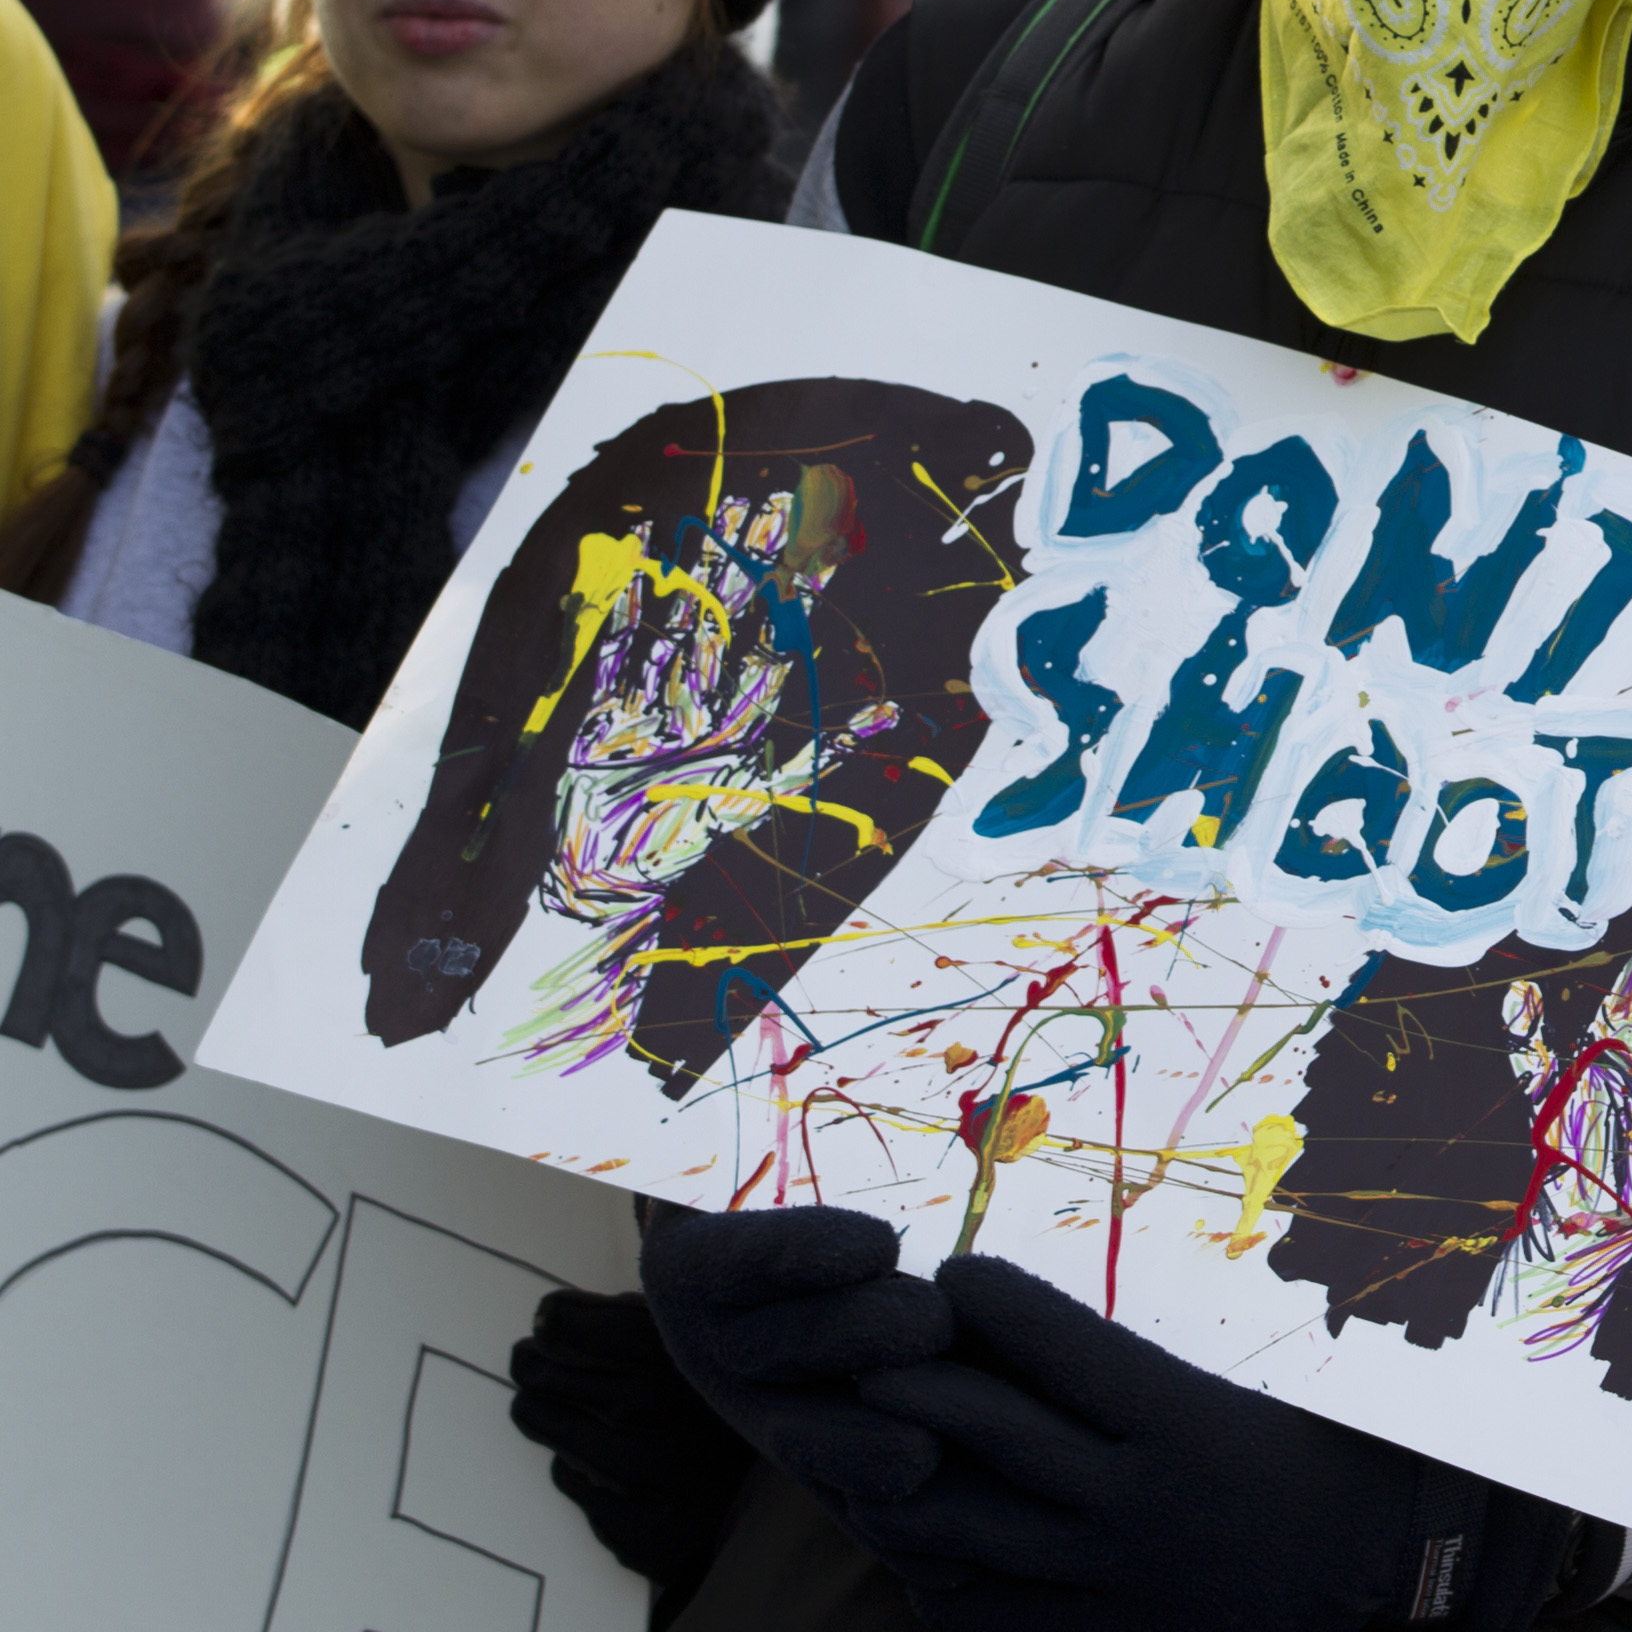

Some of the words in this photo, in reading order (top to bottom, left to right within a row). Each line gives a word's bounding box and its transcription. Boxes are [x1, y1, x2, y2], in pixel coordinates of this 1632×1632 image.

[1325, 74, 1343, 123] Cotton
[1335, 132, 1350, 167] Made
[1344, 170, 1356, 184] in
[1351, 188, 1385, 235] China
